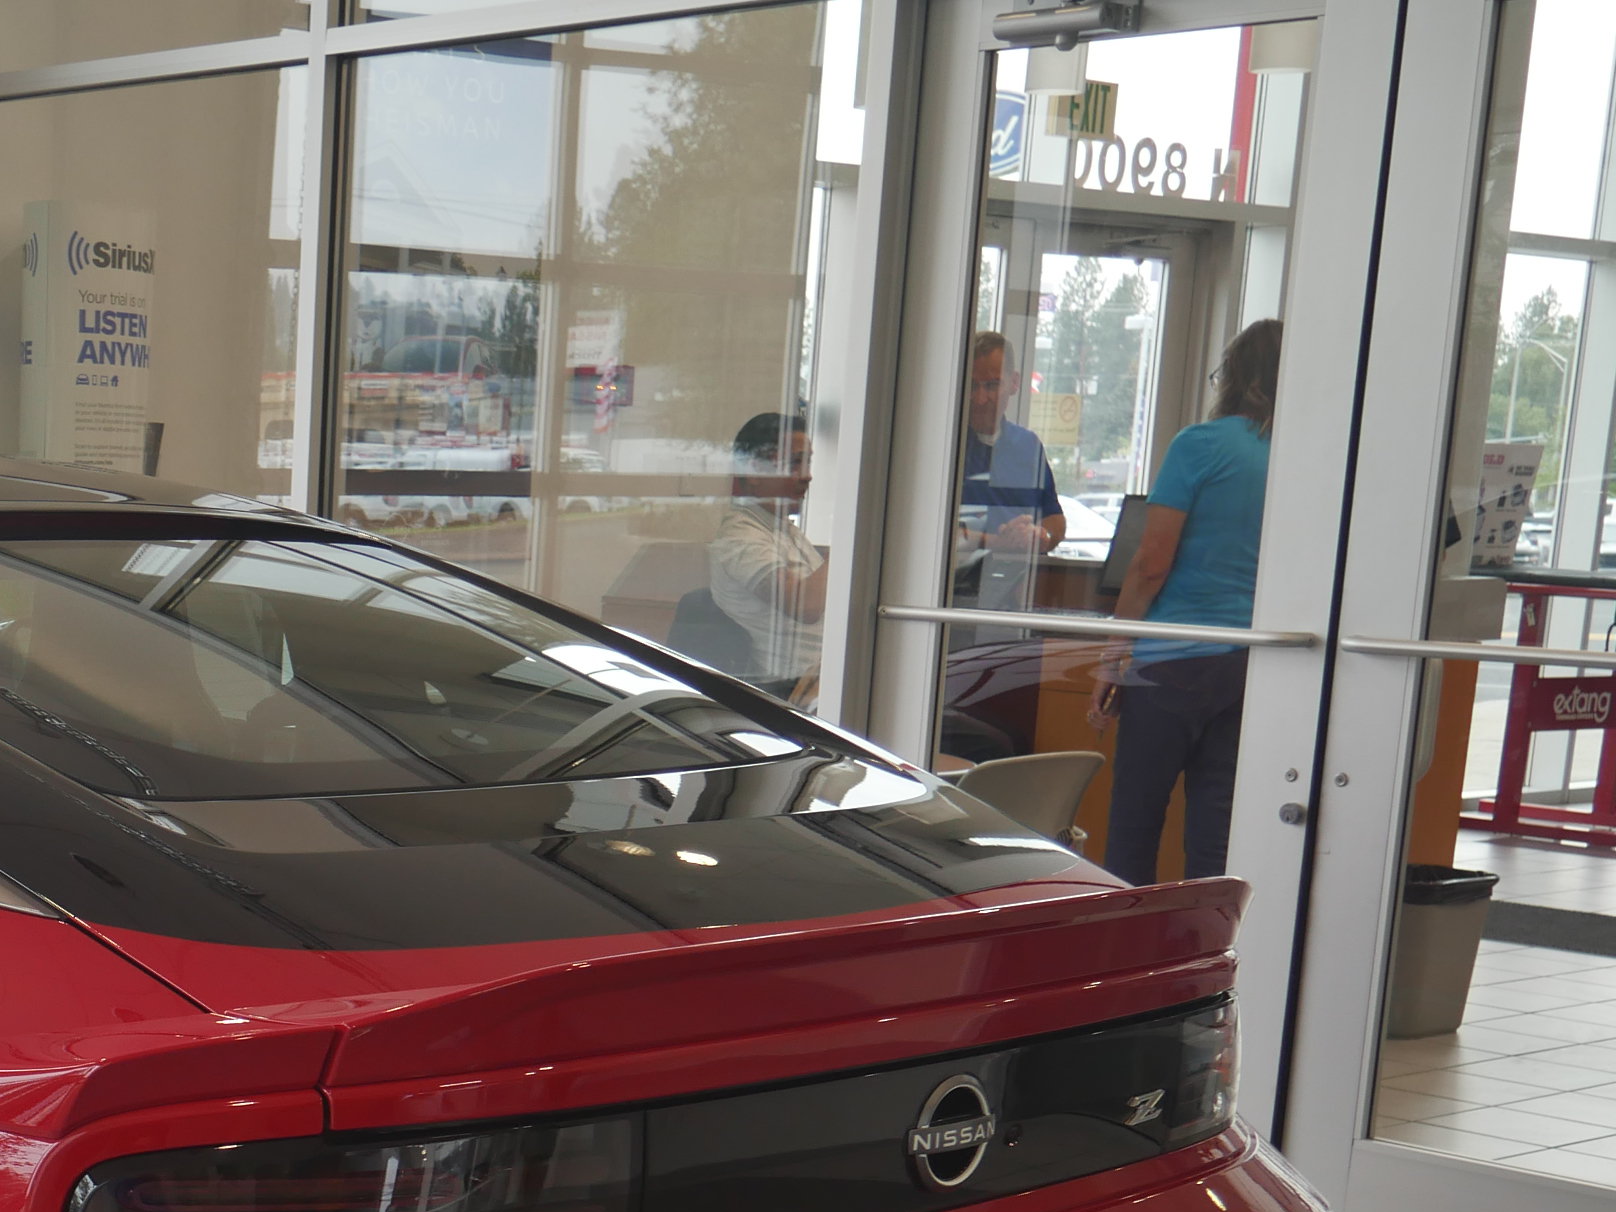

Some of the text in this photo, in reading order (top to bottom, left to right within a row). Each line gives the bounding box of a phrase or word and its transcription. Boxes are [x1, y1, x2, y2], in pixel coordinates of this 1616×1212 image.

[1069, 83, 1111, 135] EXIT
[78, 289, 106, 304] Your
[110, 292, 127, 305] trial
[78, 309, 148, 338] LISTEN
[1553, 686, 1612, 723] extang
[913, 1121, 995, 1151] NISSAN
